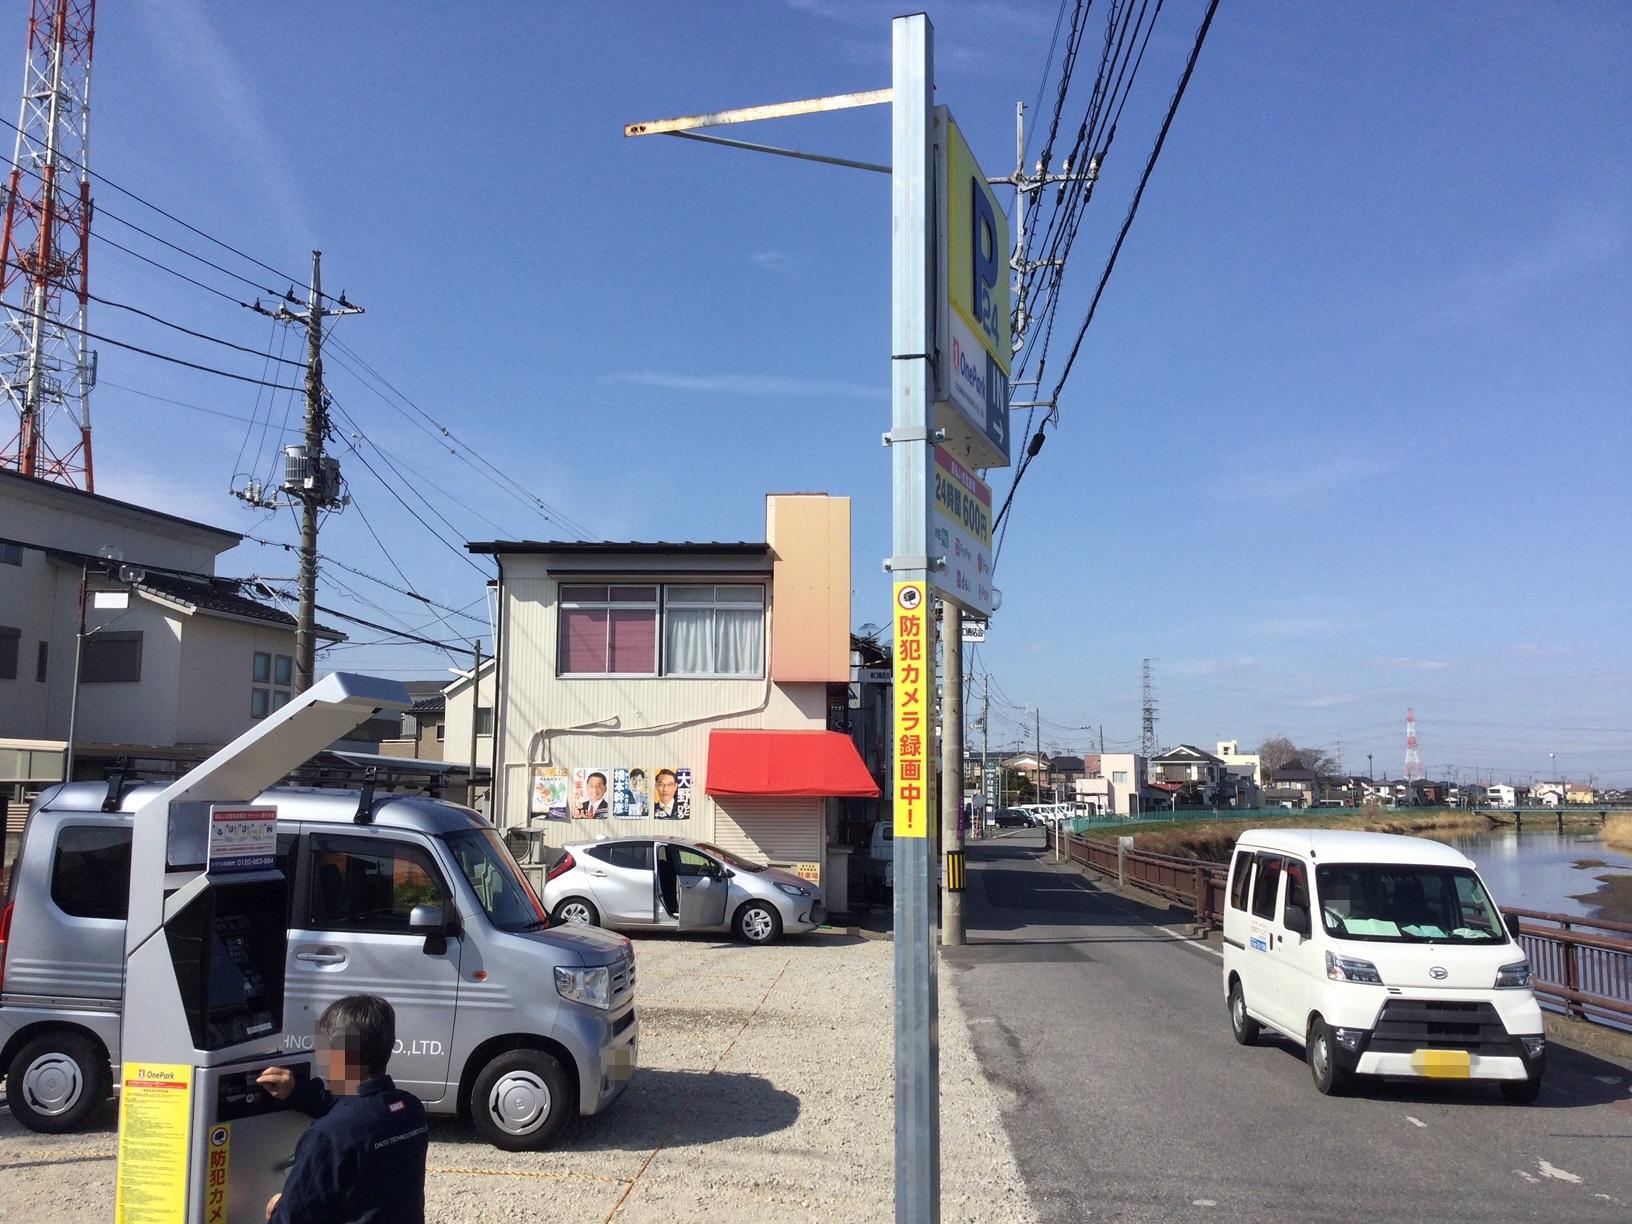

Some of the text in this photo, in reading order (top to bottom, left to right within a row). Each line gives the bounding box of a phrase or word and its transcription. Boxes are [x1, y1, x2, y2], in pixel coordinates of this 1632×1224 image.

[972, 175, 998, 324] P
[960, 351, 986, 400] OnePark
[993, 365, 1005, 414] IN
[963, 494, 987, 542] 600円
[899, 614, 921, 828] 防犯カメラ録画中!
[392, 1039, 445, 1056] O.,LTD.
[146, 1070, 174, 1080] OnePark
